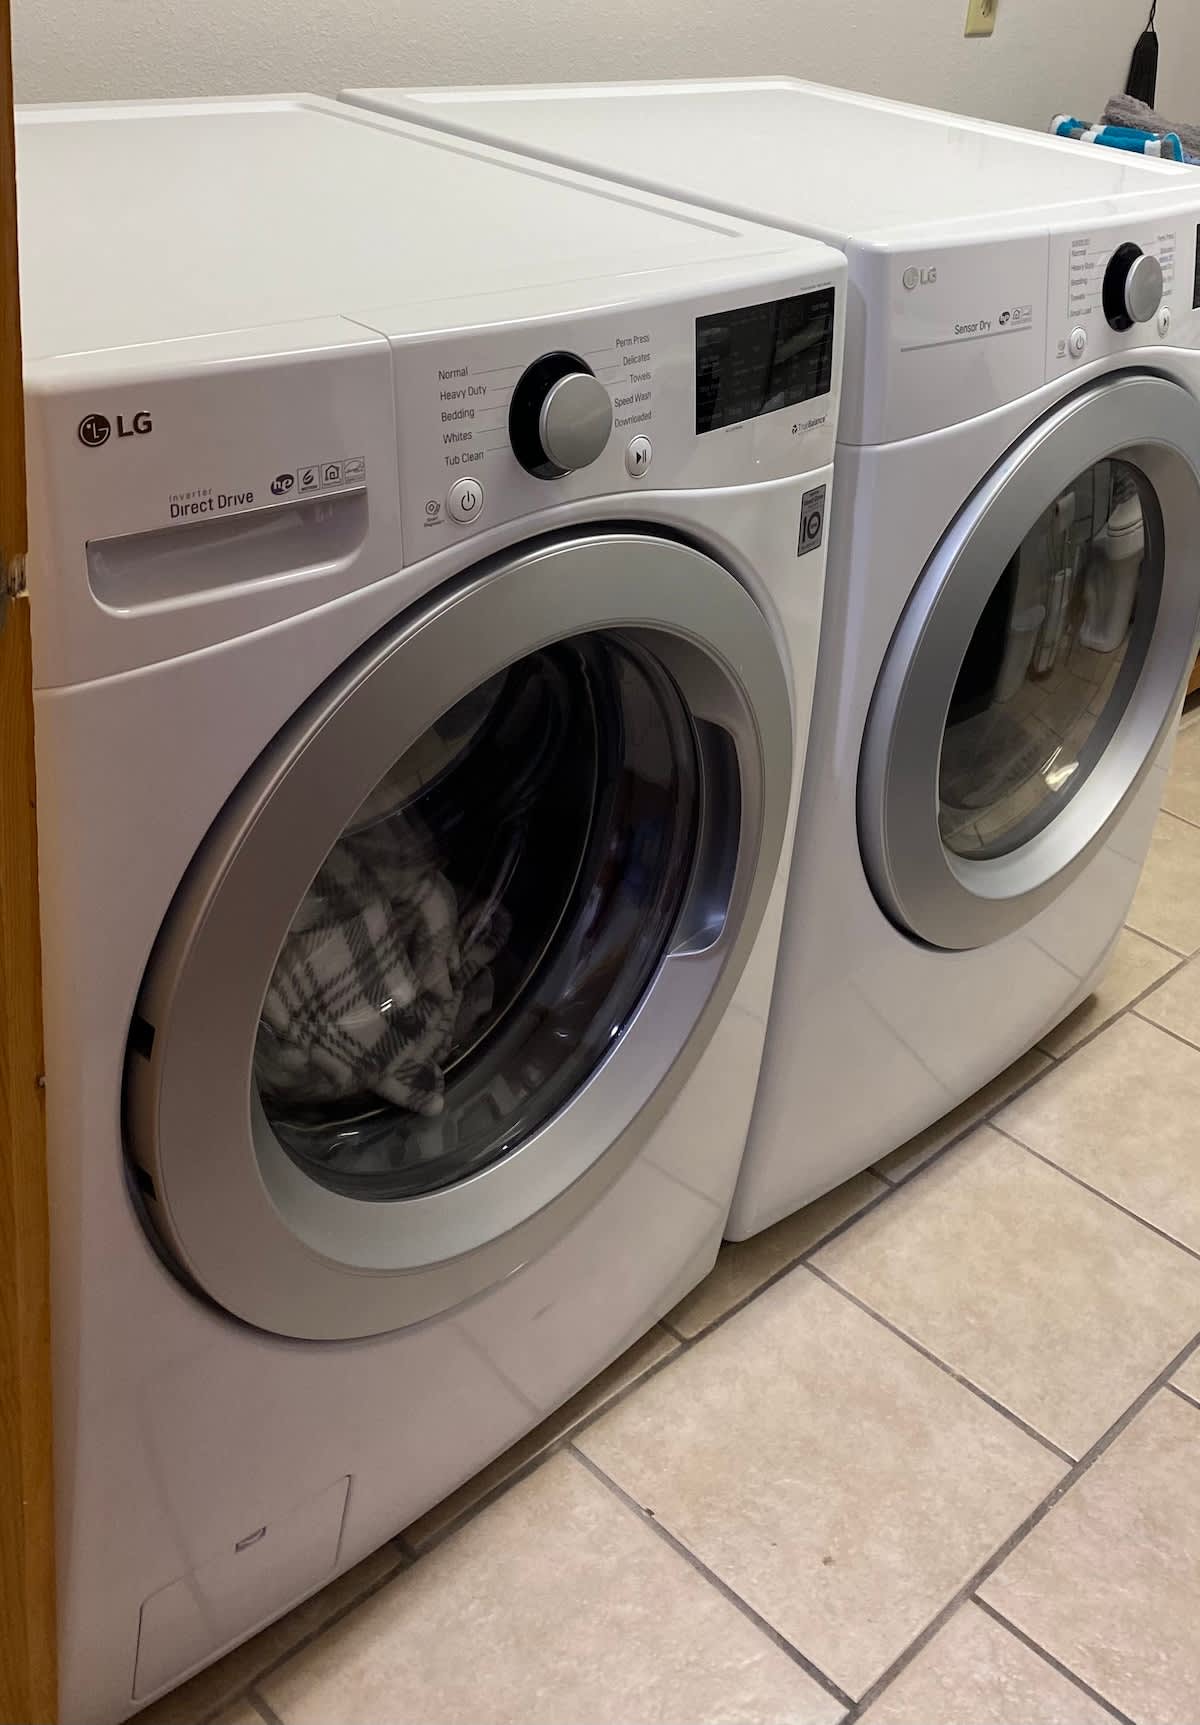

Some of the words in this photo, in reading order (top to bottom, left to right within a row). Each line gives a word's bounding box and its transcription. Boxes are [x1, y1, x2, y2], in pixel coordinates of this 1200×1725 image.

[919, 265, 937, 285] LG
[954, 322, 979, 336] Sensor
[979, 319, 992, 332] Dry
[615, 338, 633, 349] Perm
[633, 335, 650, 345] Press
[622, 353, 651, 367] Delicates
[437, 366, 469, 380] Normal
[629, 372, 652, 384] Towels
[440, 388, 467, 401] Heavy
[467, 385, 487, 397] Duty
[614, 395, 634, 408] Speed
[634, 391, 652, 403] Wash
[441, 408, 475, 422] Bedding
[614, 410, 652, 428] Downloaded
[116, 411, 153, 438] LG
[442, 431, 473, 445] Whites
[444, 454, 461, 467] Tub
[461, 450, 485, 464] Clean
[169, 497, 214, 519] Direct
[217, 491, 254, 510] Drive
